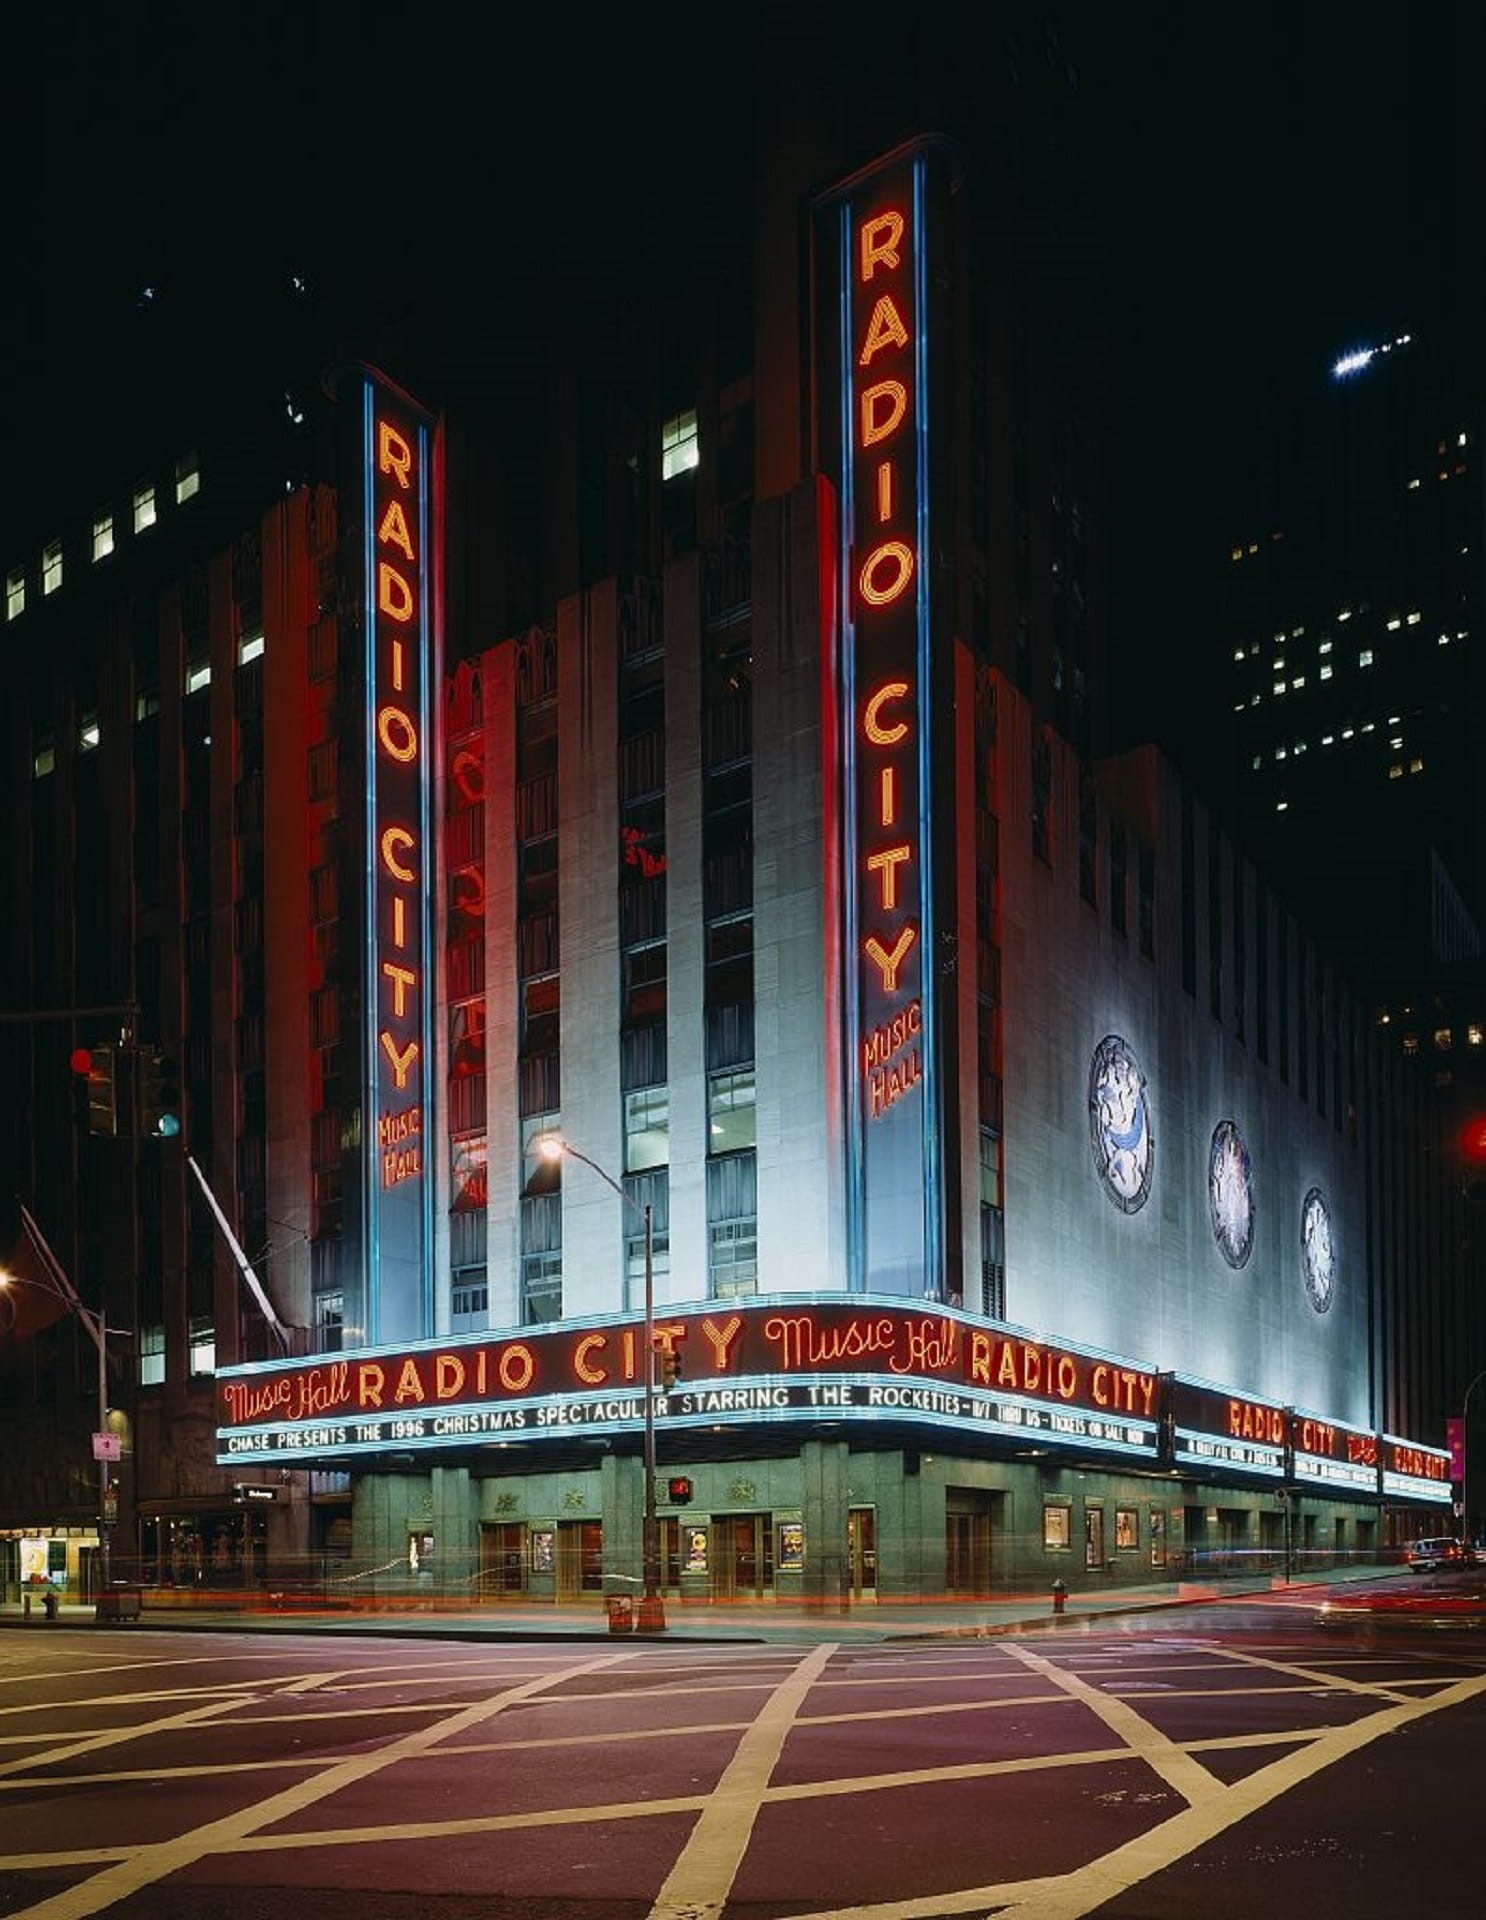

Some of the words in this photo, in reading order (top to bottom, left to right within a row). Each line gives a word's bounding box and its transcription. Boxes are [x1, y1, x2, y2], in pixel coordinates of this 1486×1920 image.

[860, 210, 914, 605] RADIO
[378, 421, 417, 761] RADIO
[864, 683, 915, 992] CITY
[381, 827, 418, 1088] CITY
[863, 1004, 921, 1076] MUSIC
[869, 1052, 922, 1119] HALL
[378, 1108, 419, 1146] MUSIC
[384, 1149, 419, 1188] HALL
[359, 1345, 533, 1407] RADIO
[574, 1317, 740, 1383] CITY
[765, 1317, 895, 1370] Music
[890, 1317, 957, 1373] Hall
[972, 1331, 1076, 1398] RADIO
[1092, 1365, 1153, 1415] CITY
[225, 1379, 291, 1423] Music
[288, 1362, 350, 1420] Hall
[228, 1435, 268, 1453] CHASE
[278, 1427, 346, 1448] PRESENTS
[356, 1425, 381, 1441] THE
[391, 1420, 424, 1438] 1996
[433, 1411, 525, 1434] CHRISTMAS
[682, 1388, 789, 1412] STARRING
[809, 1386, 851, 1405] THE
[1229, 1400, 1283, 1443] RADIO
[1303, 1420, 1334, 1455] CITY
